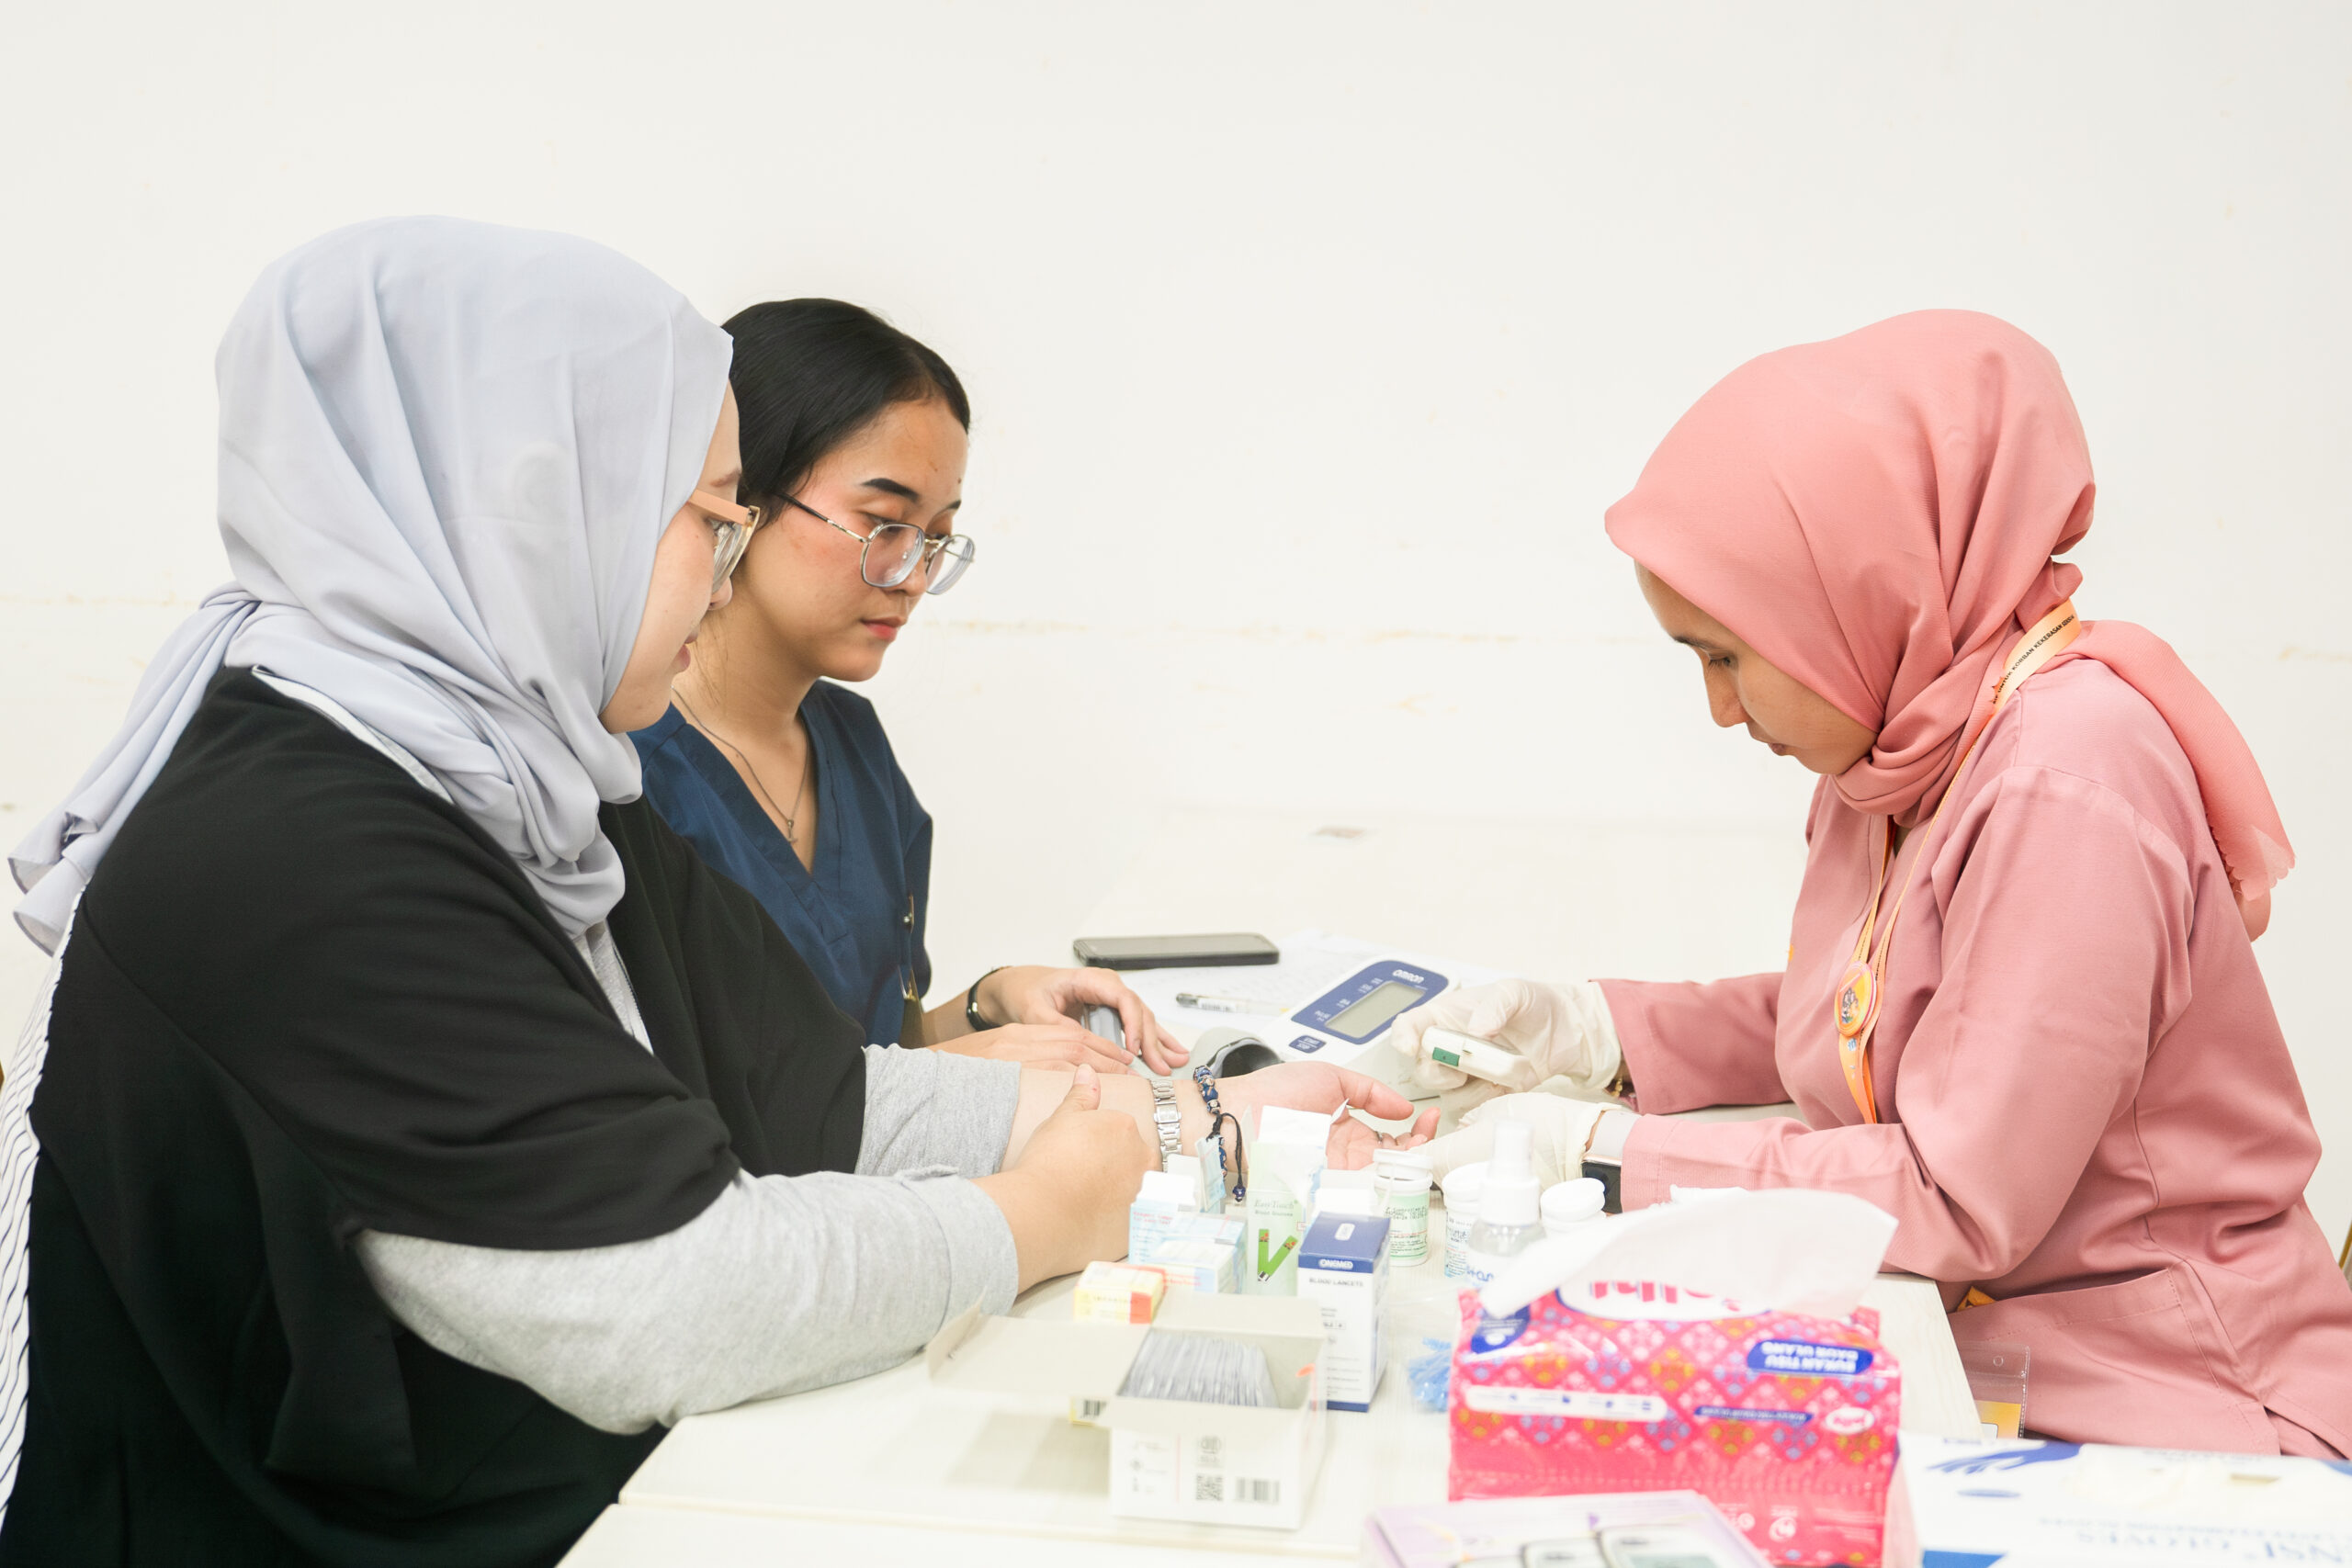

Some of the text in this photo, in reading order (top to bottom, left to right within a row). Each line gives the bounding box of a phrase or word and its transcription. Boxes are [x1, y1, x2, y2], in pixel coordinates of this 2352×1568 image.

[2012, 648, 2035, 671] KORBAN
[2034, 625, 2063, 649] KEKERASAN
[1392, 969, 1425, 984] OMRON
[1309, 1277, 1363, 1288] BLOOD LANCETS
